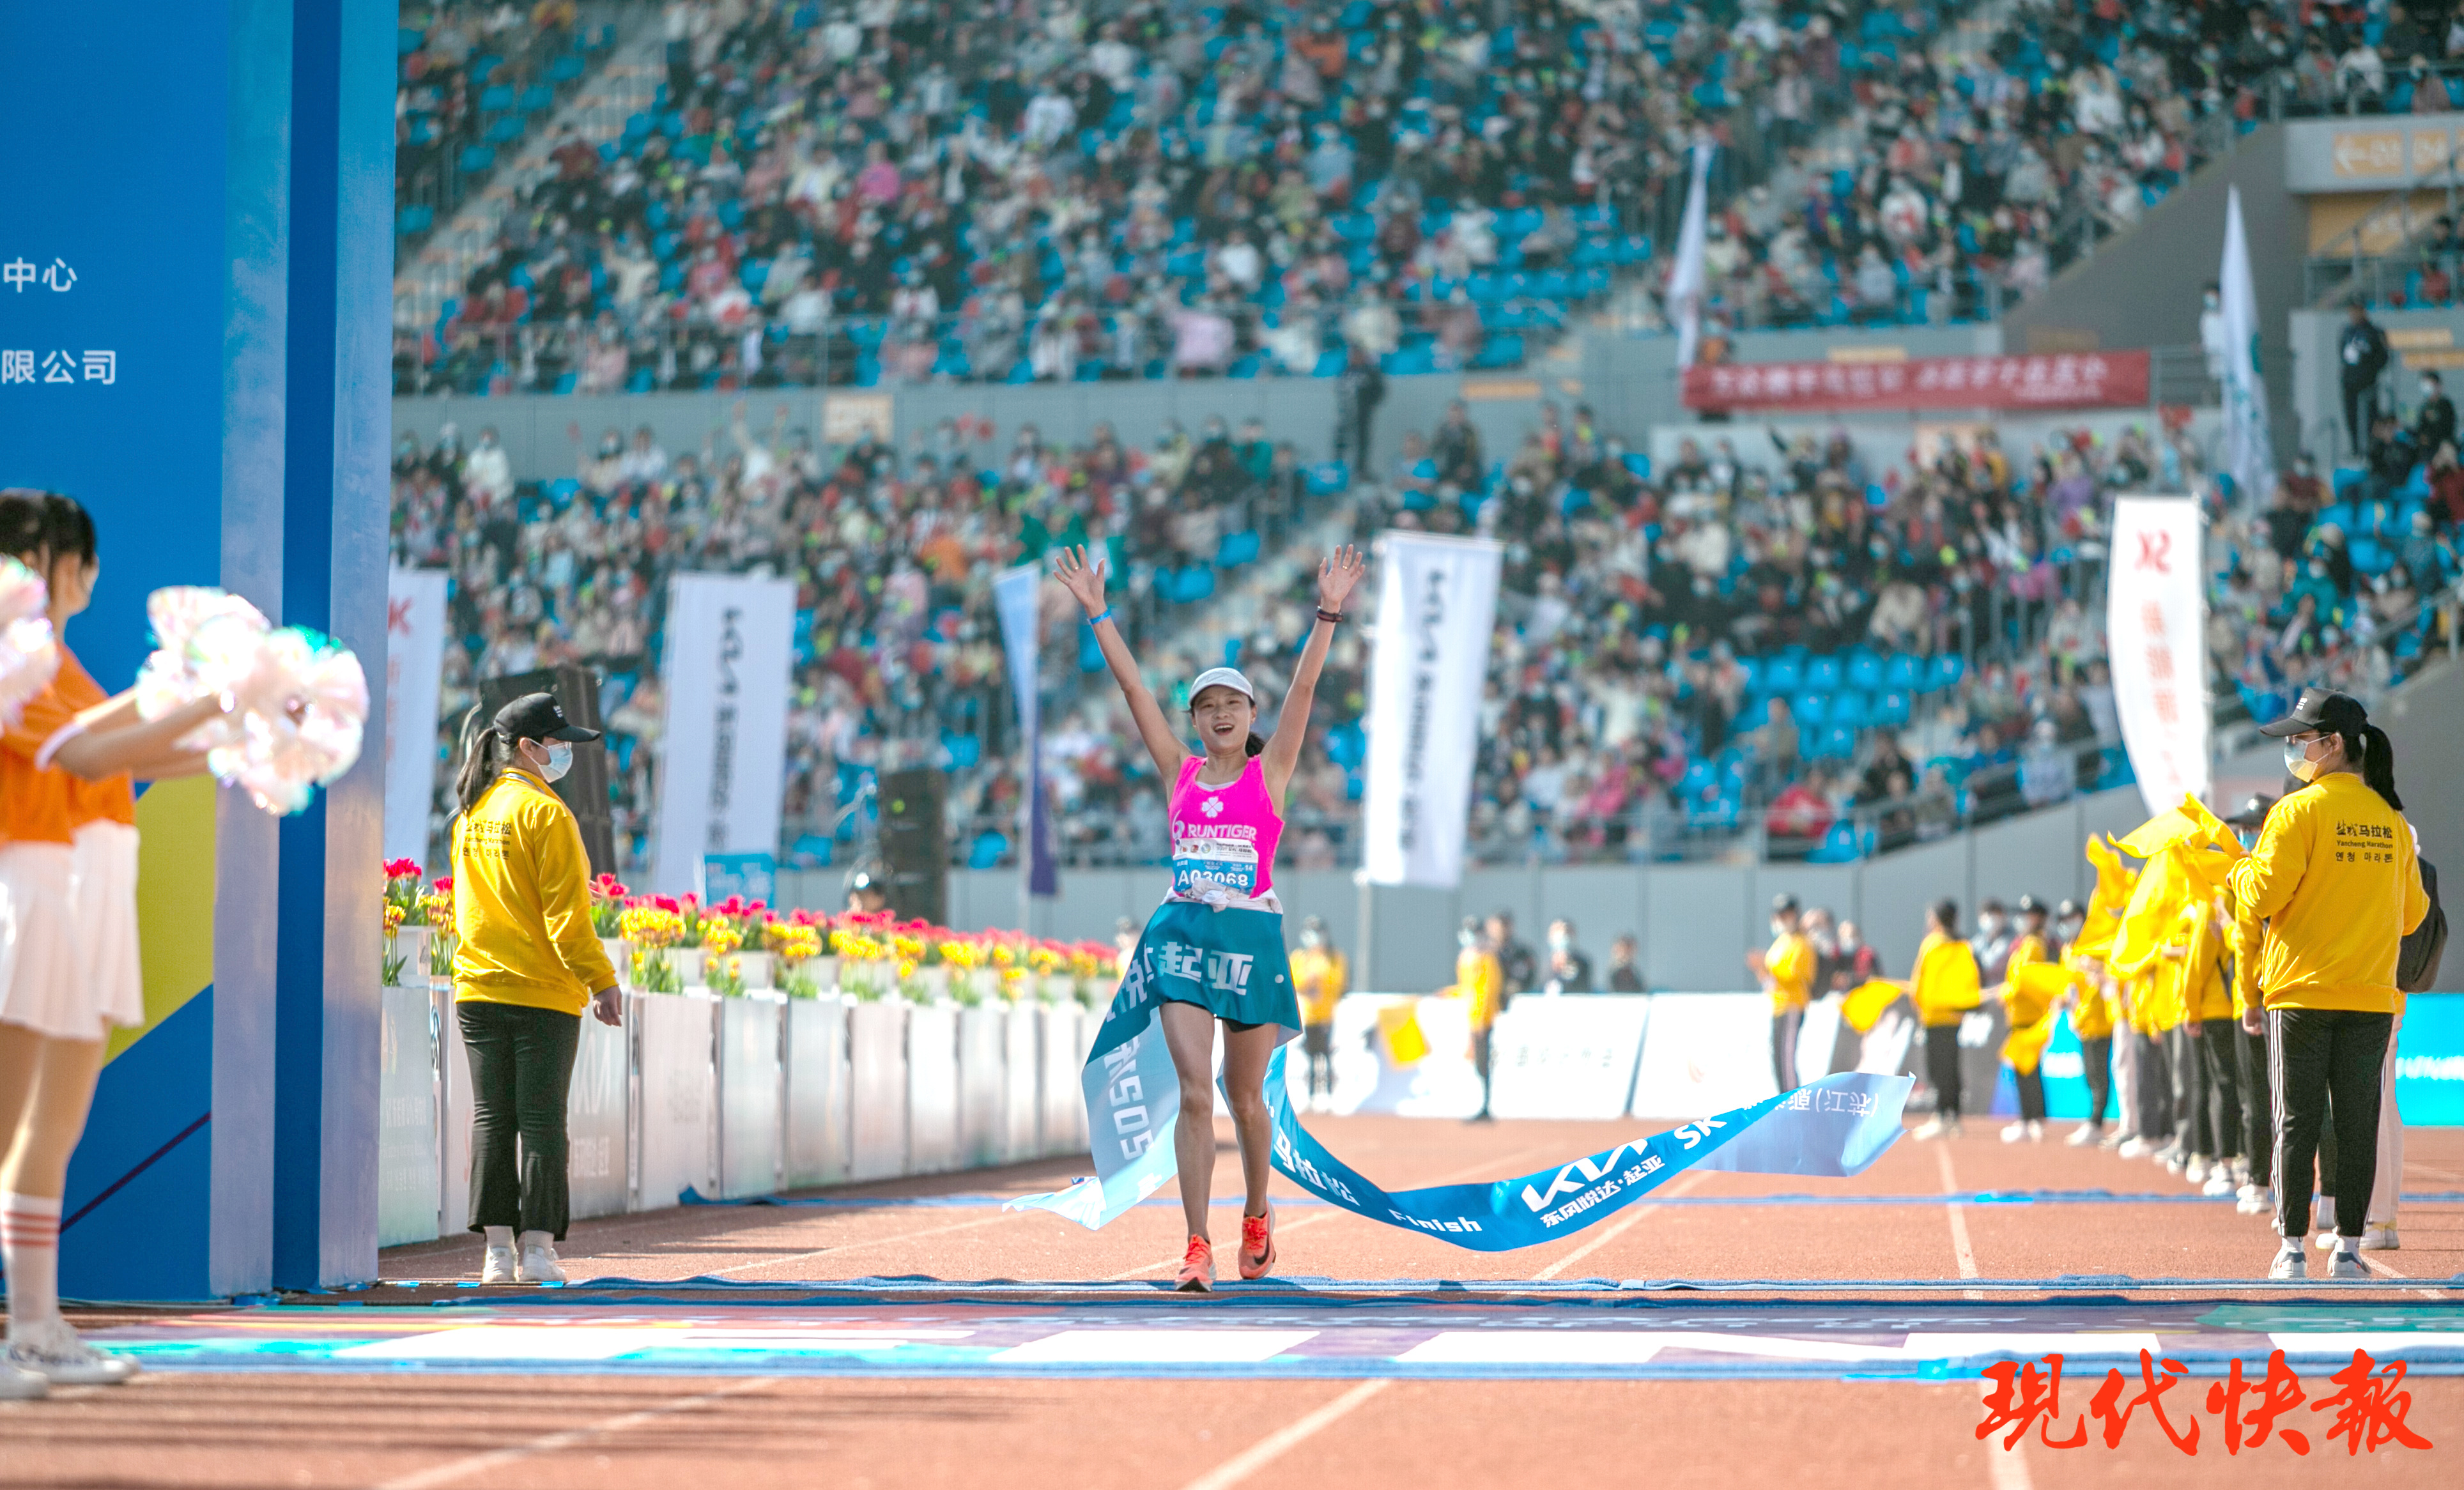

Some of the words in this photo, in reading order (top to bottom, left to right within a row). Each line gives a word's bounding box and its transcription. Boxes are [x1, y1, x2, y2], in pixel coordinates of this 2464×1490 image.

[3, 257, 77, 293] 中心
[1, 349, 116, 384] 限公司
[1187, 824, 1257, 841] RUNTIGER
[2364, 852, 2394, 863] 마라톤
[1177, 870, 1249, 887] A03068
[1674, 1116, 1727, 1149] SK
[1274, 1125, 1360, 1206] 马拉松
[1387, 1208, 1482, 1233] Finish
